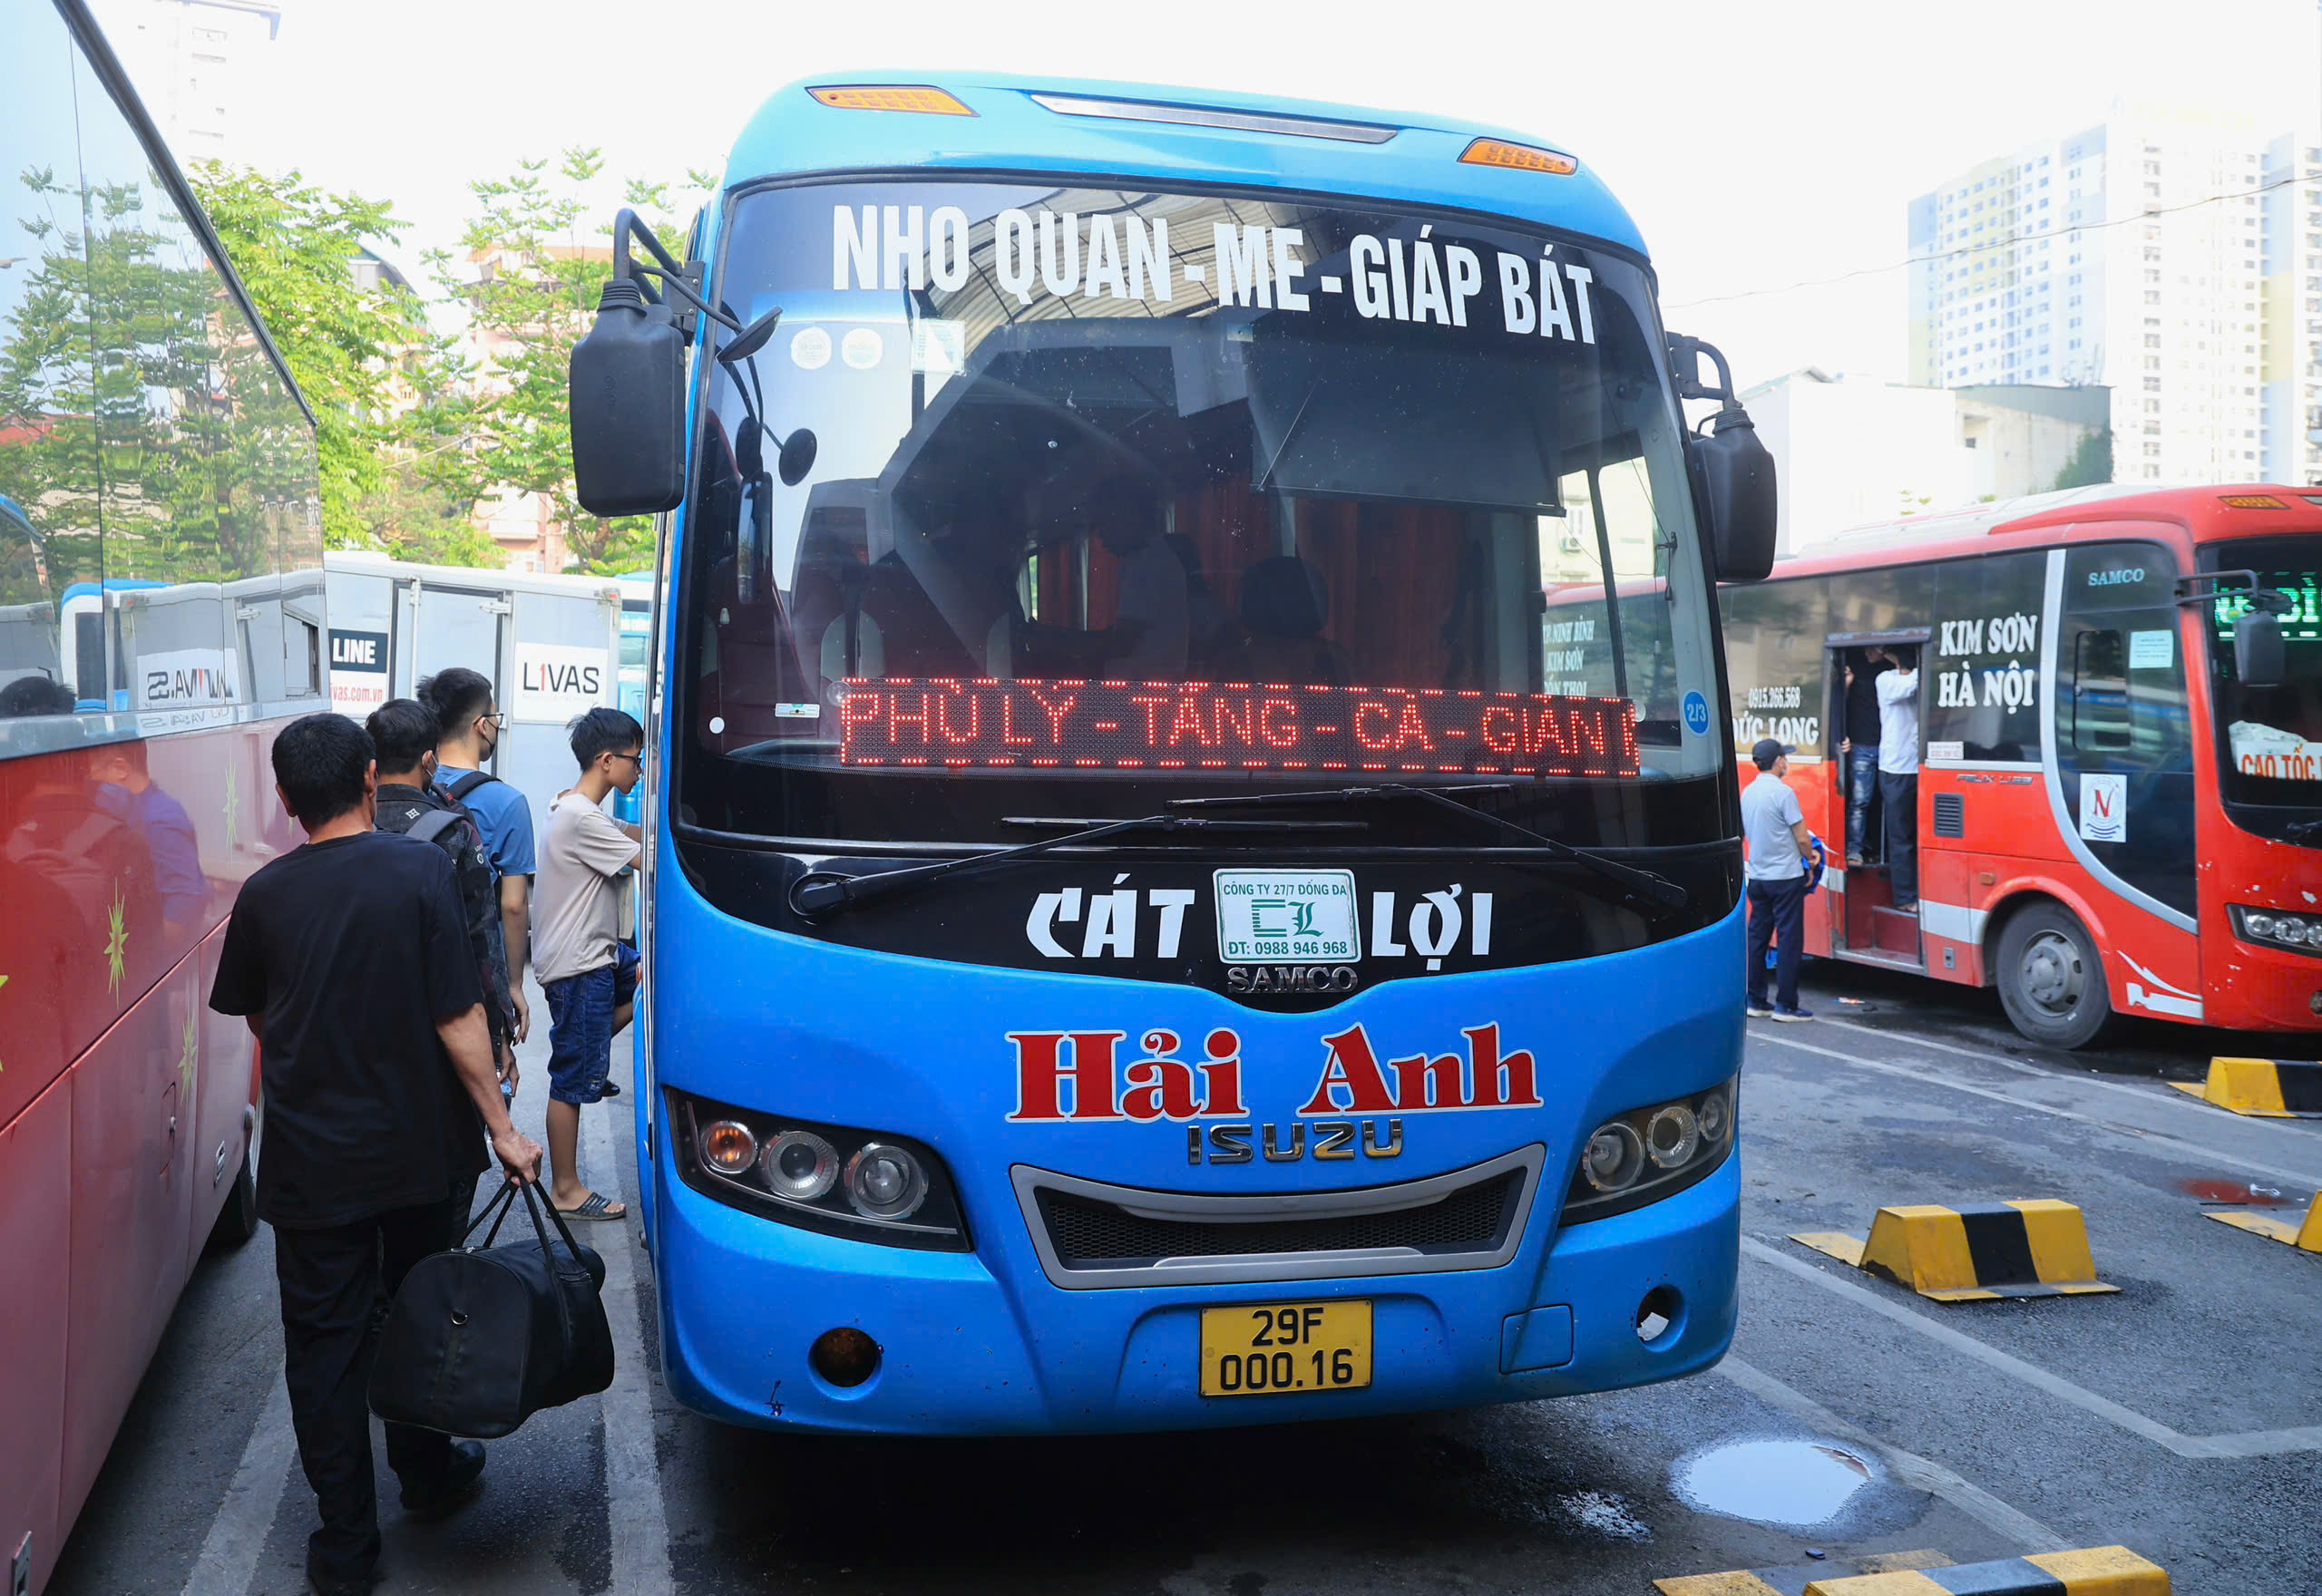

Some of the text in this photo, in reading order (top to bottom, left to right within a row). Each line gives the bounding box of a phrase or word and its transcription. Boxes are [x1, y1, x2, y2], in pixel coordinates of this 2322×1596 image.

[834, 205, 969, 291] NHO
[995, 207, 1171, 305] QUAN
[1215, 222, 1310, 312] ME
[1351, 224, 1483, 327] GIÁP
[1501, 244, 1595, 345] BÁT
[2088, 569, 2145, 587] SAMCO
[333, 637, 376, 665] LINE
[1939, 611, 2038, 657] KIM SƠN
[1937, 659, 2035, 715] HÀ NỘI
[1686, 704, 1706, 722] 2/3
[1224, 880, 1347, 896] CÔNG TY 27/7 ĐỐNG ĐA
[1026, 873, 1493, 970] CÁT LỢI
[1228, 941, 1348, 954] ĐT: 0988 946 968
[1227, 966, 1359, 993] SAMCO
[1004, 1021, 1545, 1124] Hải Anh
[1186, 1119, 1403, 1165] ISUZU
[1252, 1307, 1324, 1347] 29F
[1220, 1348, 1353, 1390] 000.16
